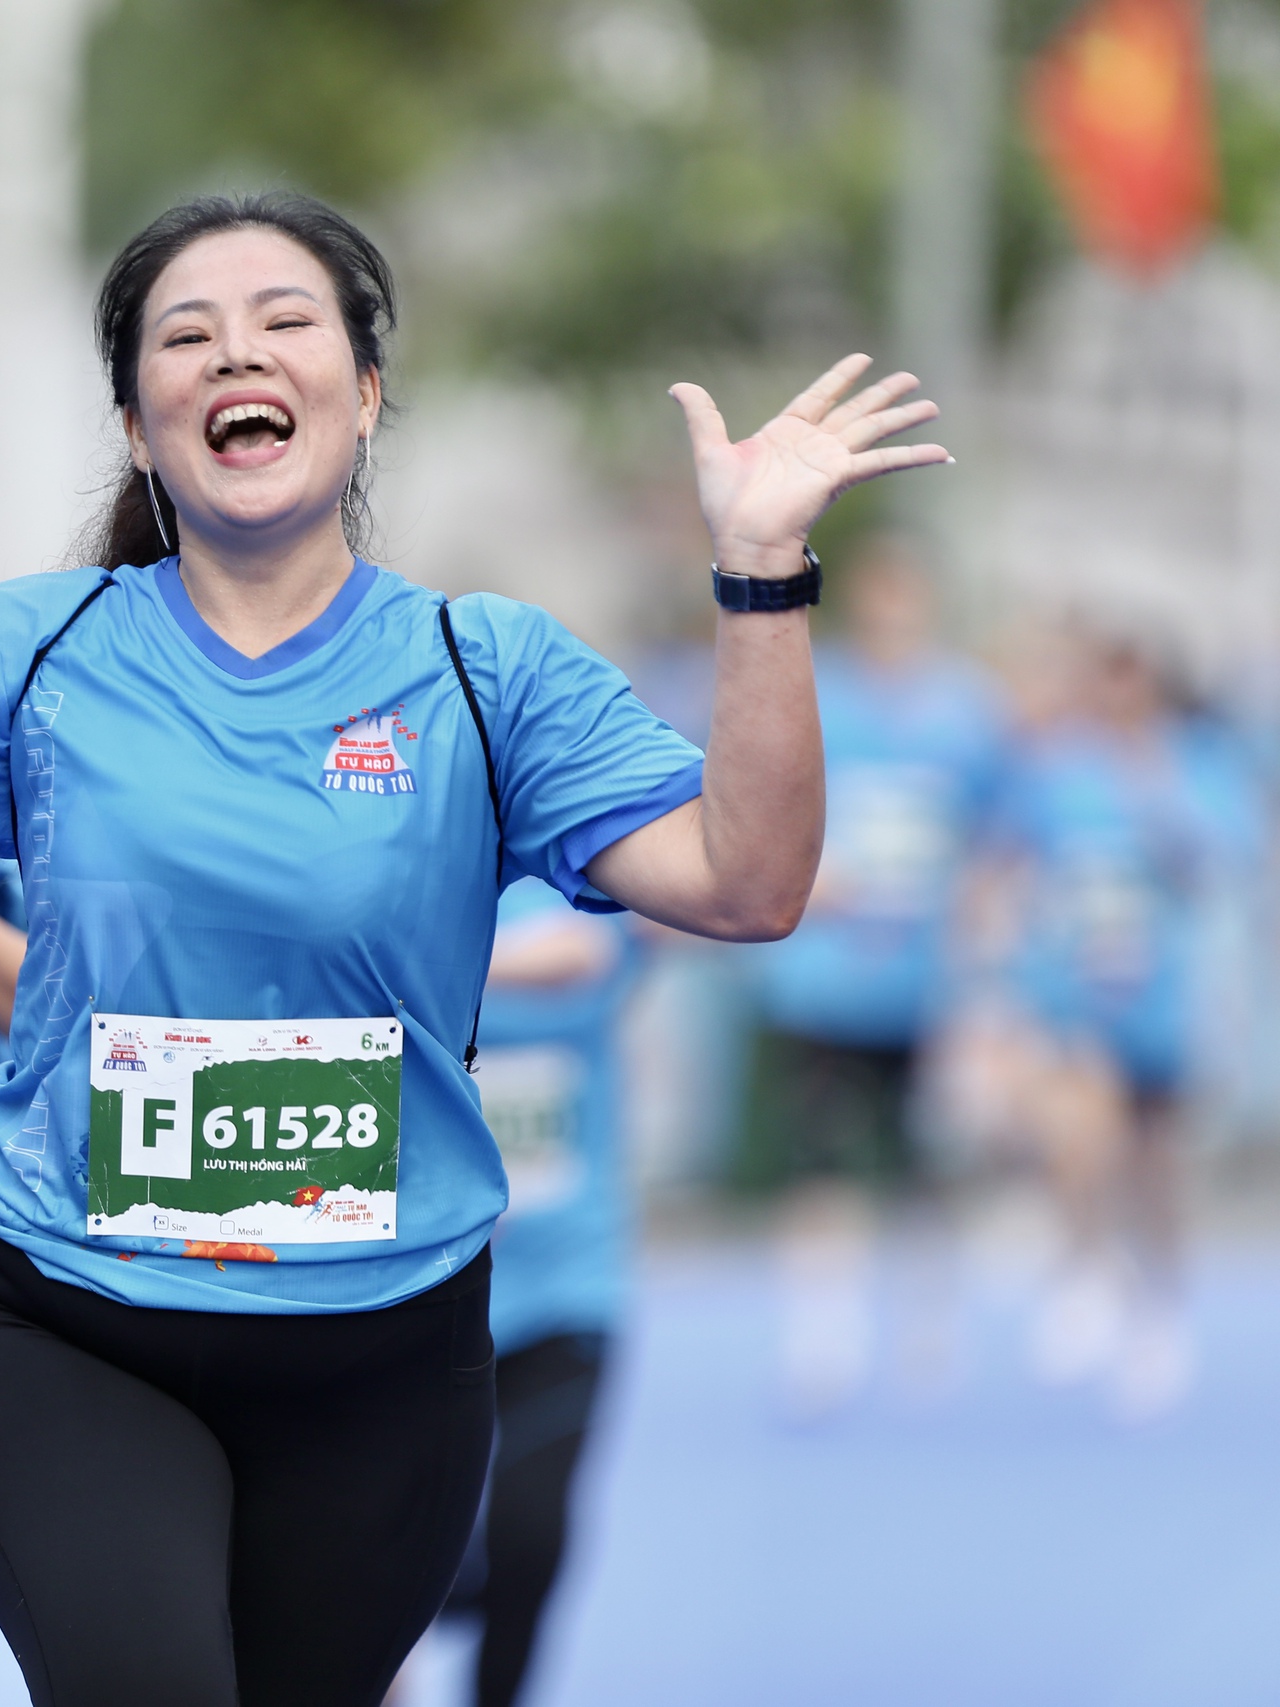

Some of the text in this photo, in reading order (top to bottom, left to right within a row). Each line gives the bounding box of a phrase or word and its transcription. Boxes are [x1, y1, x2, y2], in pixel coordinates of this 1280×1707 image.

[339, 755, 391, 770] TỰ HÀO
[325, 770, 414, 795] TỔ QUỐC TÔI
[360, 1032, 390, 1052] 6 KM
[142, 1097, 380, 1150] F 61528
[203, 1158, 227, 1170] LƯU
[228, 1160, 248, 1173] THỊ
[249, 1157, 284, 1171] HỒNG
[171, 1223, 188, 1232] Size
[237, 1228, 263, 1236] Medal
